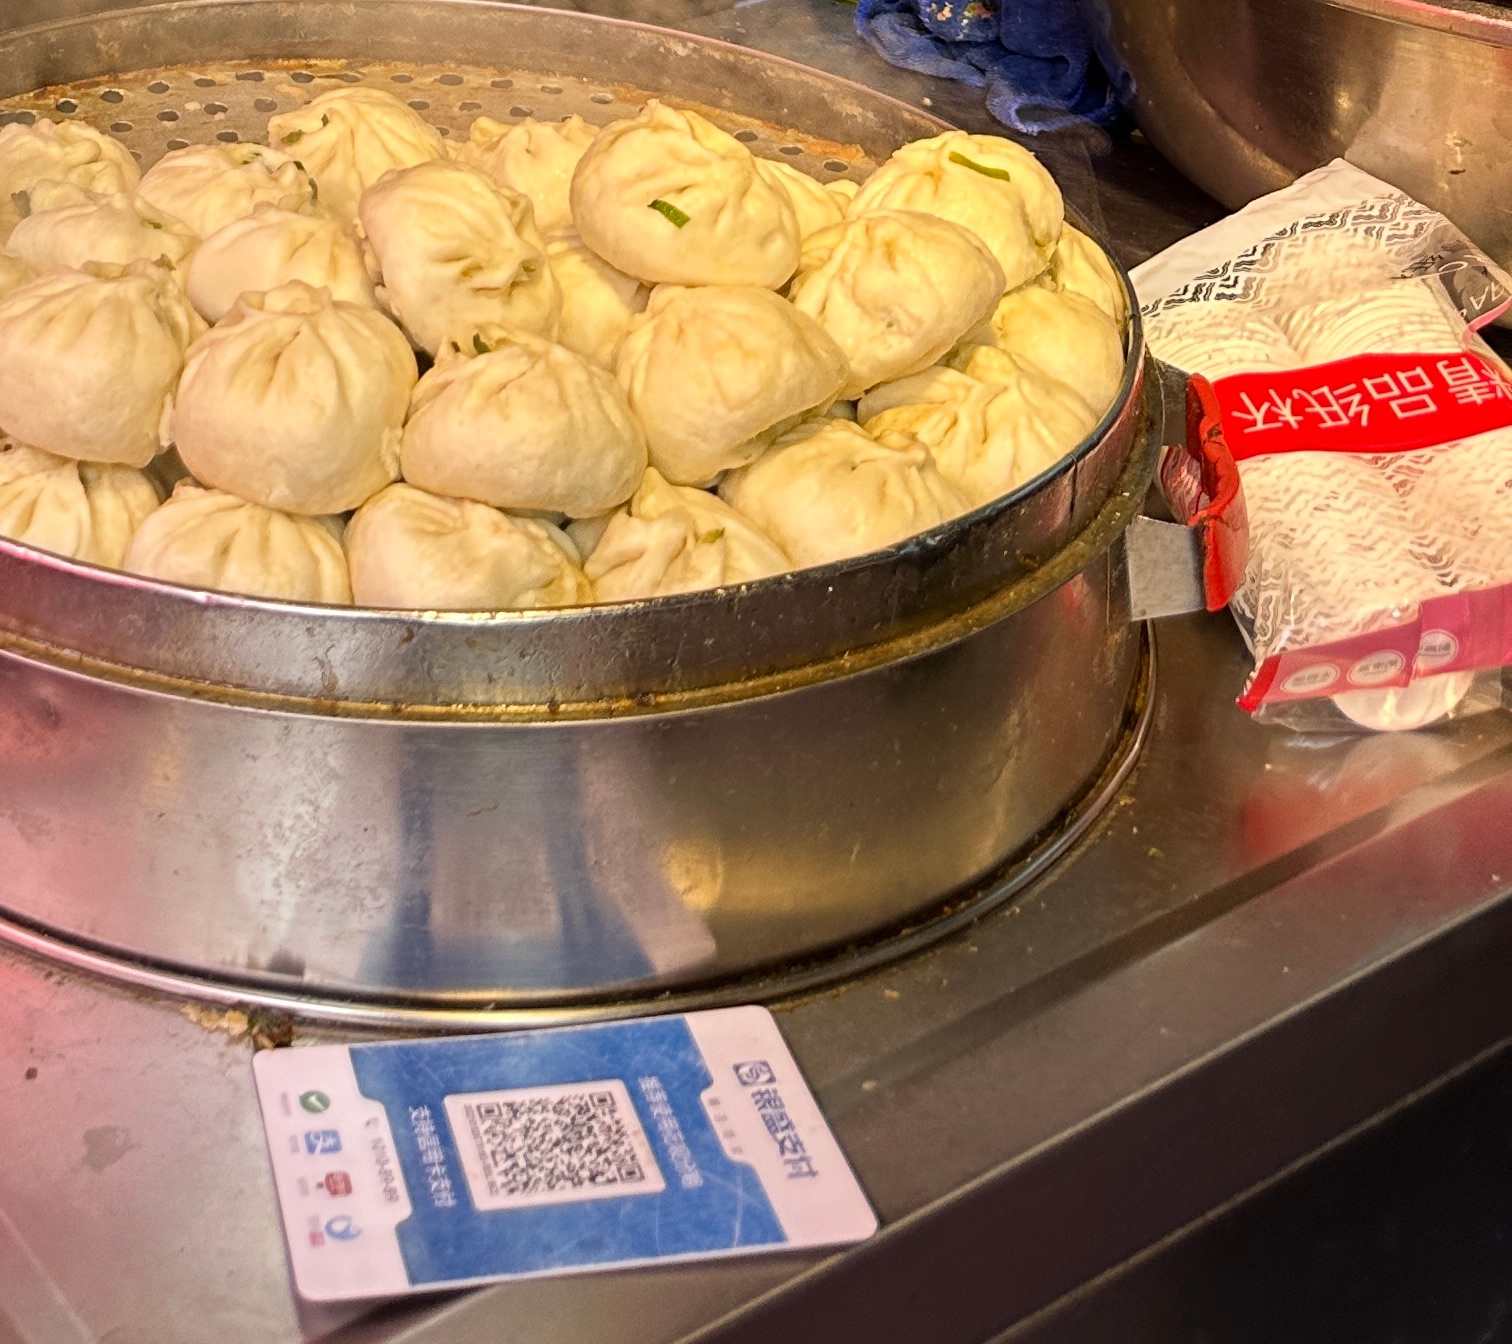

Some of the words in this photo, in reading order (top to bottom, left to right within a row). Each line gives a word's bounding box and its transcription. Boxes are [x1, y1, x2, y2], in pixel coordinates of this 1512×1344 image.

[1232, 355, 1512, 435] 精品纸杯
[750, 1087, 820, 1182] 银盛支付
